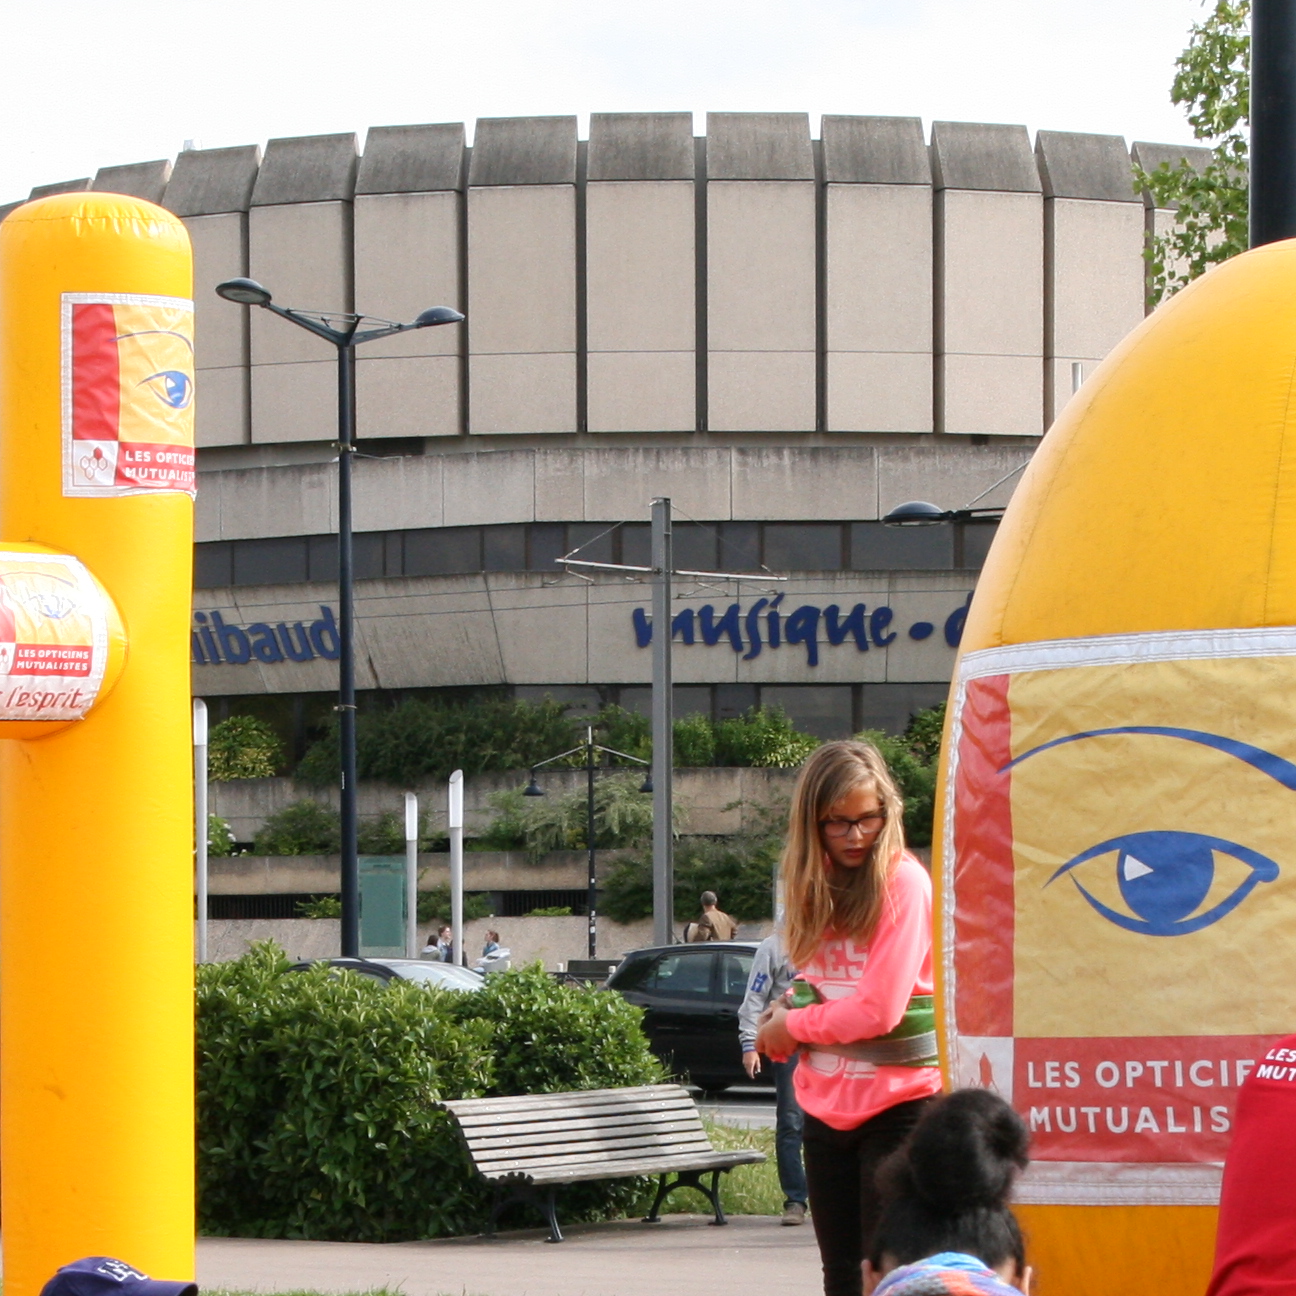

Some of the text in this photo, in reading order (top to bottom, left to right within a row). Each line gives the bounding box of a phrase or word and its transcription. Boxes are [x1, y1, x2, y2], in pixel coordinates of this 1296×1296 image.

[125, 450, 151, 462] LES
[18, 649, 89, 660] LES OPTICIENS
[16, 660, 88, 671] MUTUALISTES
[5, 686, 83, 712] l'esprit.
[1027, 1061, 1081, 1089] LES
[1030, 1105, 1230, 1134] MUTUALIS
